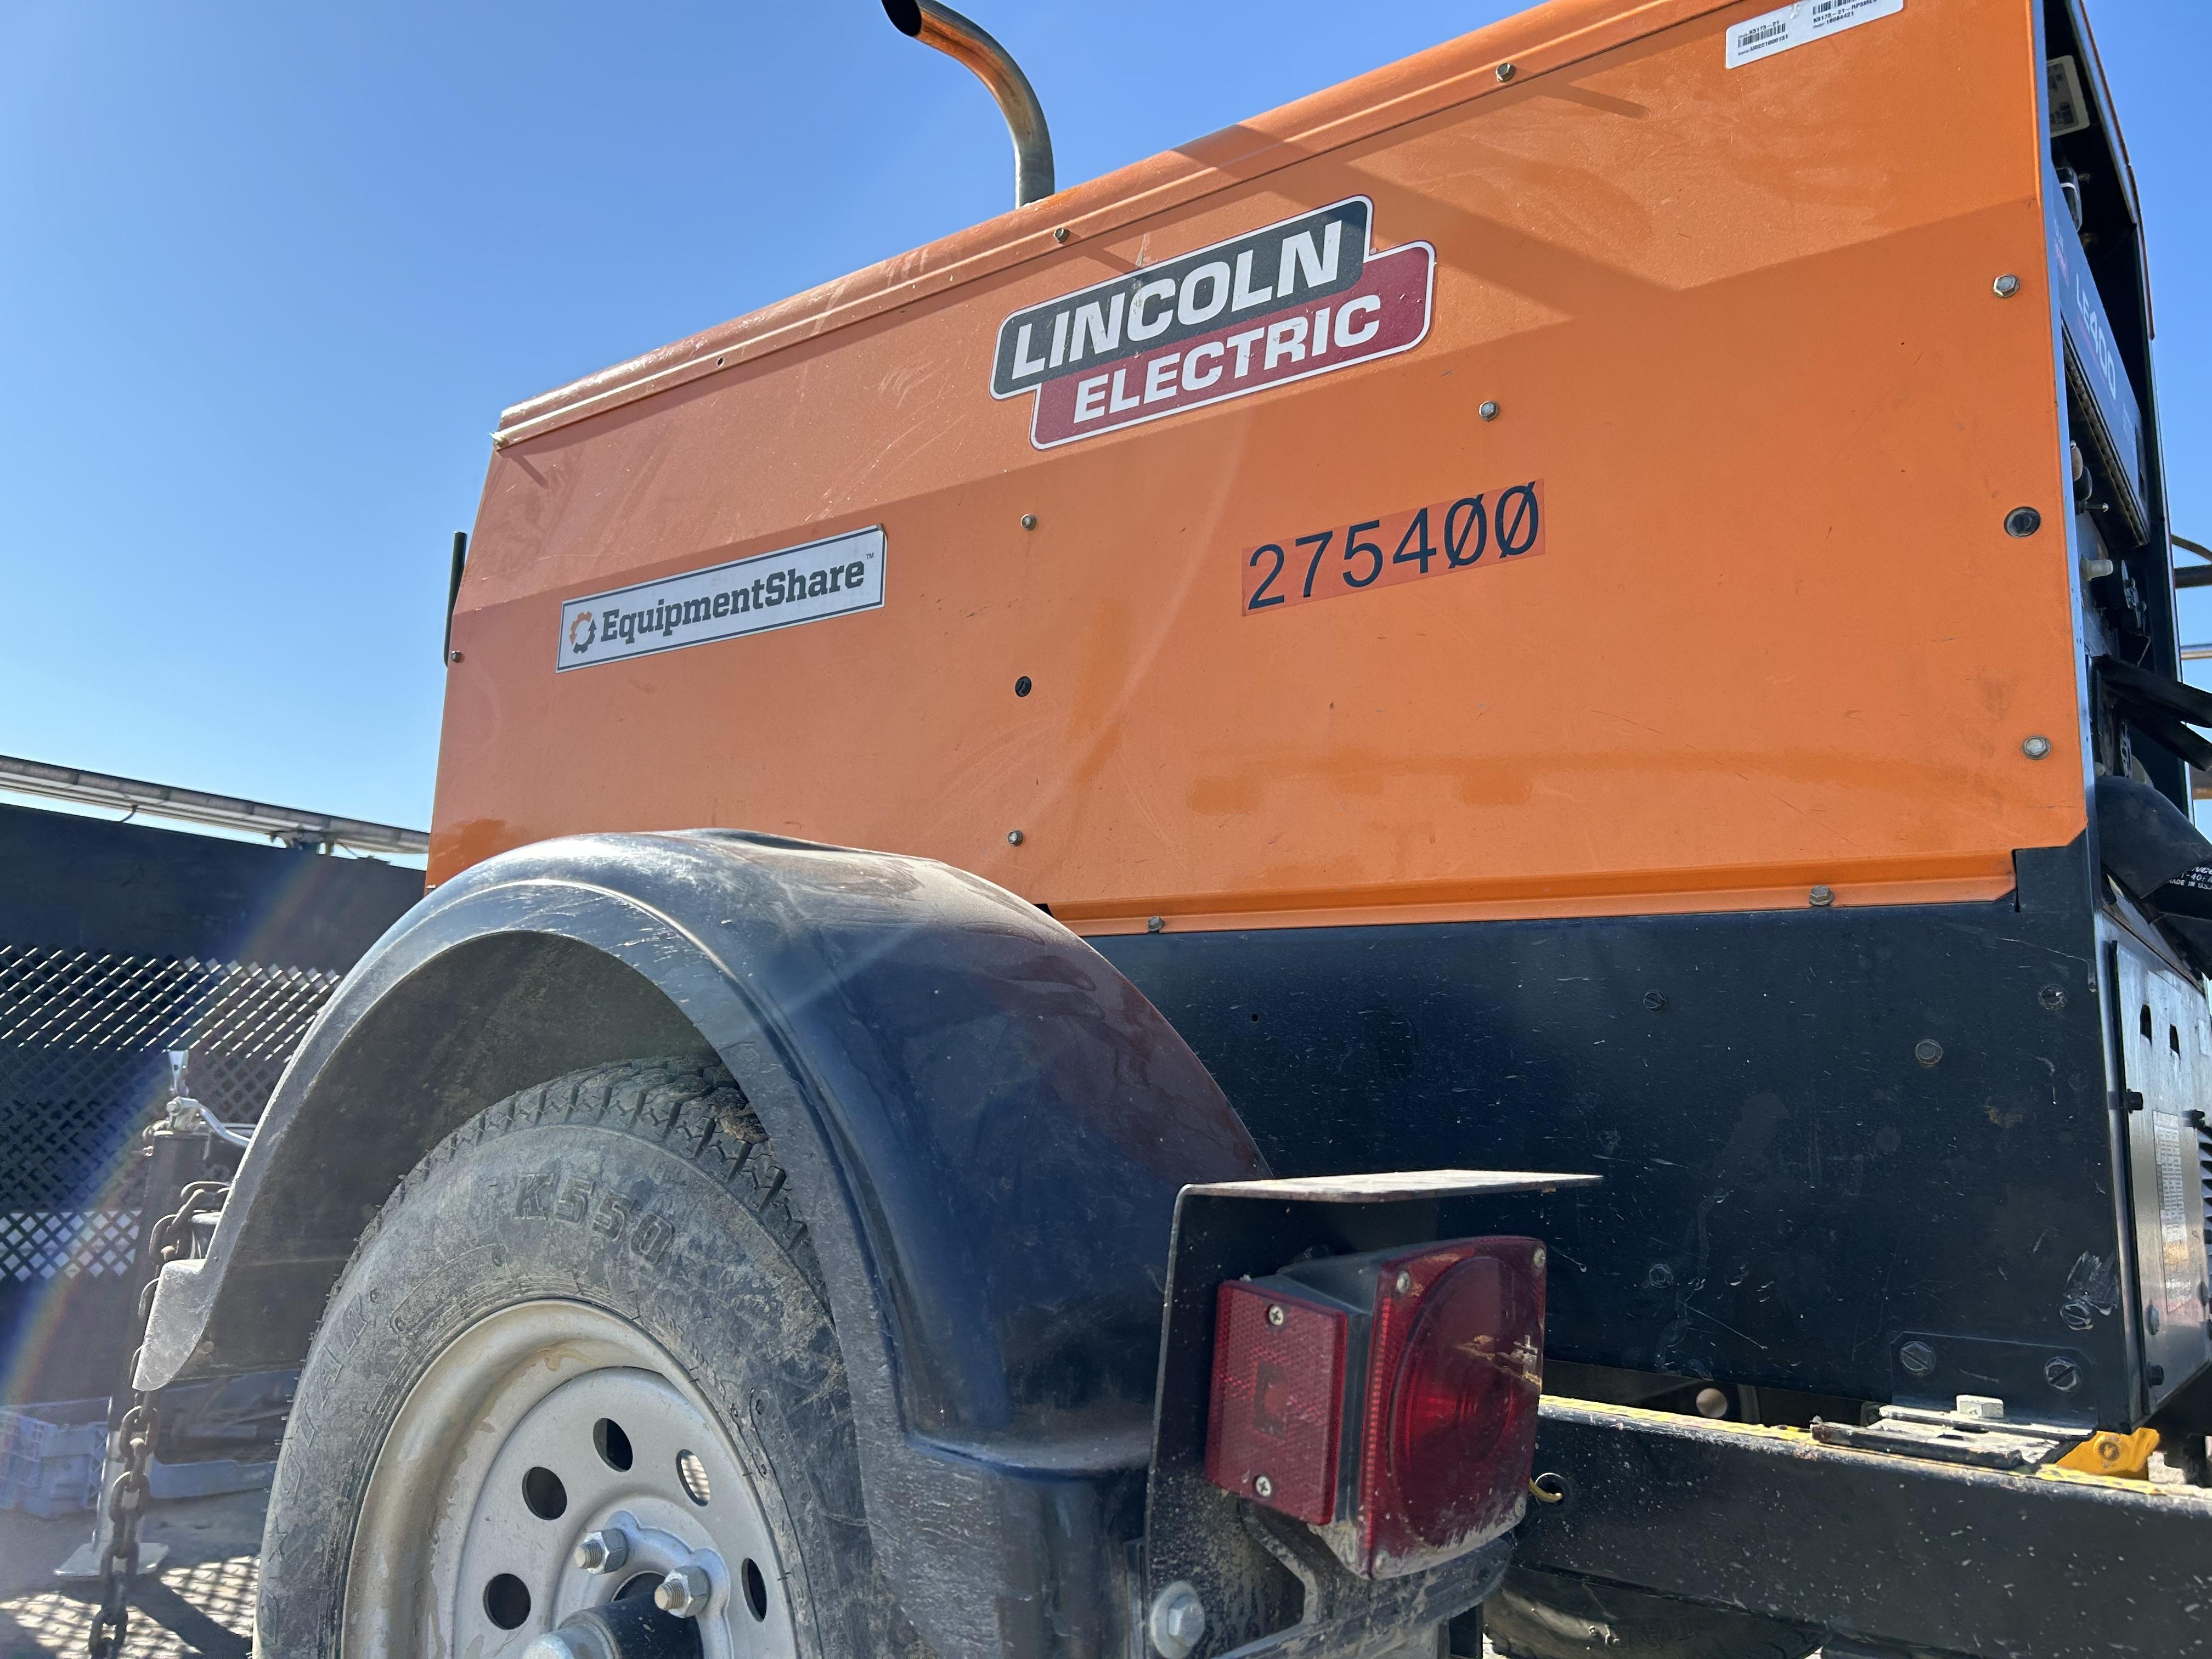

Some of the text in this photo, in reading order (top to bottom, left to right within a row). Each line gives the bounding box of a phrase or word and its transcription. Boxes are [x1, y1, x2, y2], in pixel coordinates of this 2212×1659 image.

[1012, 219, 1342, 380] LINCOLN
[1073, 295, 1381, 424] ELECTRIC
[601, 560, 865, 645] EquipmentShare
